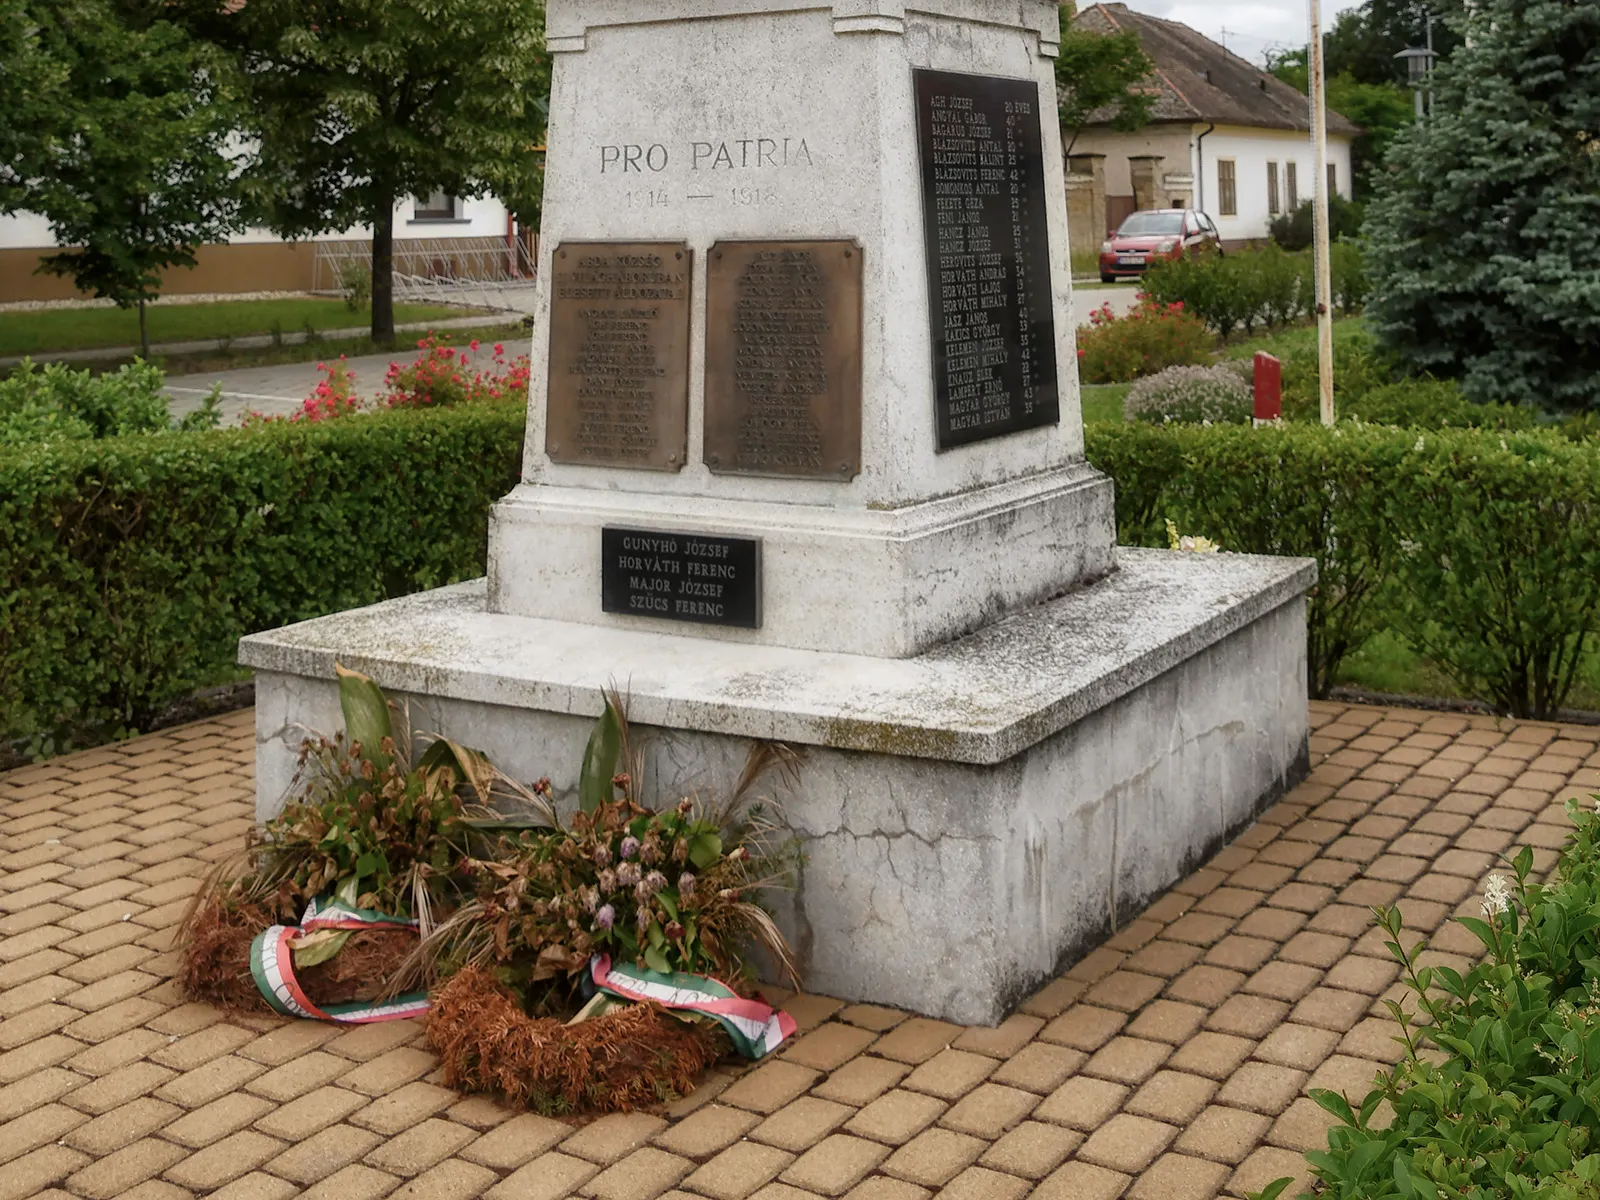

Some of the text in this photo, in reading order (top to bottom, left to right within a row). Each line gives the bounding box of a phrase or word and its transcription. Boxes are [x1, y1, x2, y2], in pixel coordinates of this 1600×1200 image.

[931, 110, 961, 122] ANGYAL
[932, 124, 965, 136] BAGARUS
[979, 141, 1002, 151] ANTAL
[600, 138, 814, 173] PRO PATRIA
[981, 169, 1006, 179] FERENC
[936, 183, 972, 194] DOMONKOS
[976, 184, 999, 194] ANTAL
[625, 189, 672, 208] 1914
[937, 198, 961, 208] FEKETE
[941, 267, 976, 282] HORVÁTH
[942, 281, 977, 297] HORVÁTH
[980, 281, 1000, 294] LAJOS
[943, 296, 977, 312] HORVÁTH
[965, 309, 987, 325] JÁNOS
[946, 341, 977, 356] KELEMEN
[947, 356, 978, 371] KELEMEN
[949, 384, 981, 400] LAMPERT
[949, 398, 980, 414] MAGYAR
[950, 413, 980, 430] MAGYAR
[623, 536, 729, 558] GUNYHÓ JÓZSEF
[619, 556, 735, 578] HORVÁTH FERENC
[630, 576, 723, 597] MAJOR JÓZSEF
[676, 600, 723, 616] FERENC
